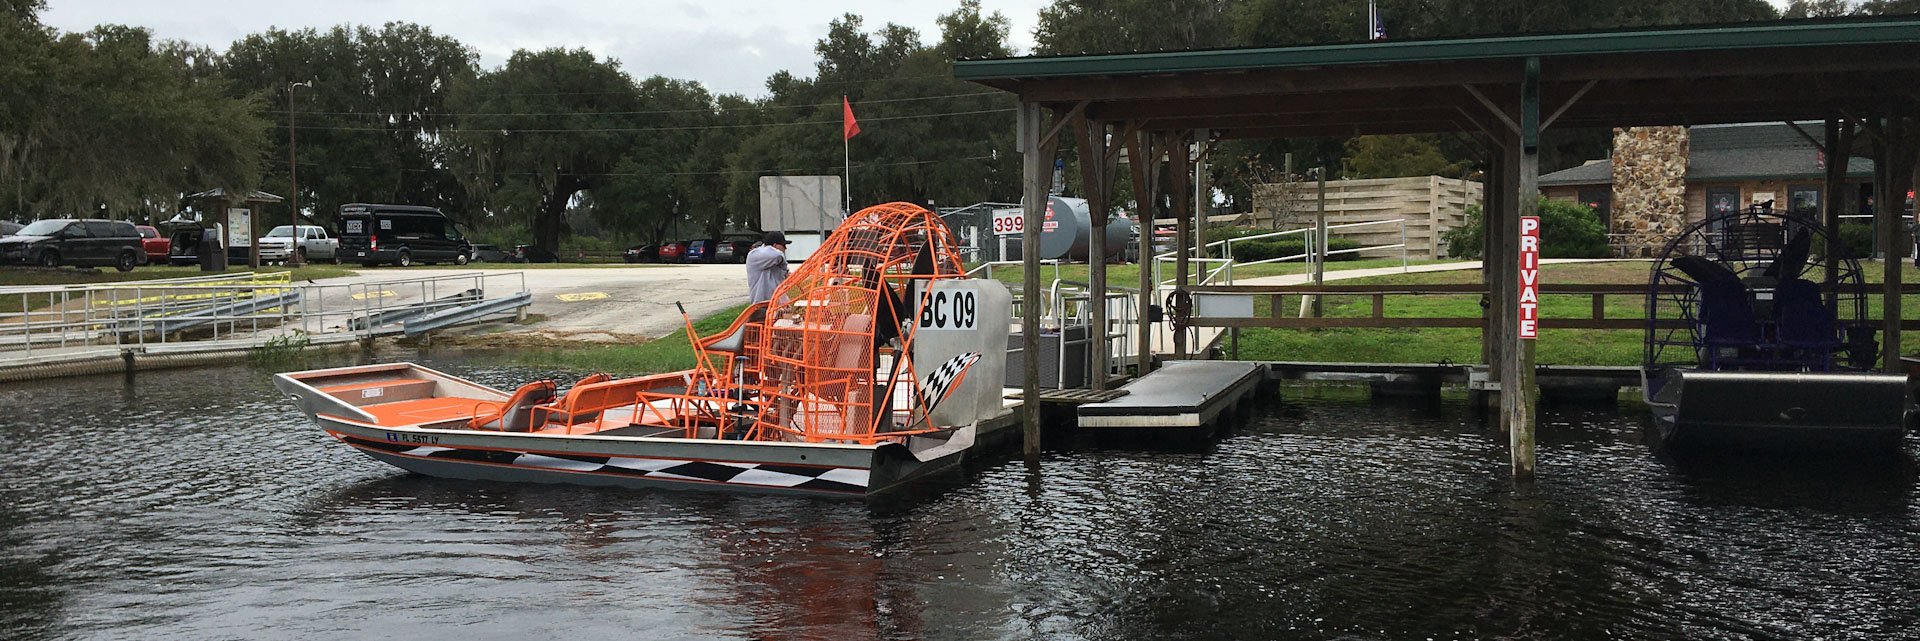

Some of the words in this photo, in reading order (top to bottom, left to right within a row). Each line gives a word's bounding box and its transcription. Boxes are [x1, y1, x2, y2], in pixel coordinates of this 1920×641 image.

[994, 216, 1024, 232] 399
[1520, 218, 1538, 337] PRIVATE
[920, 291, 947, 328] BC
[953, 291, 975, 328] 09
[402, 434, 410, 442] FL
[431, 435, 439, 444] LY
